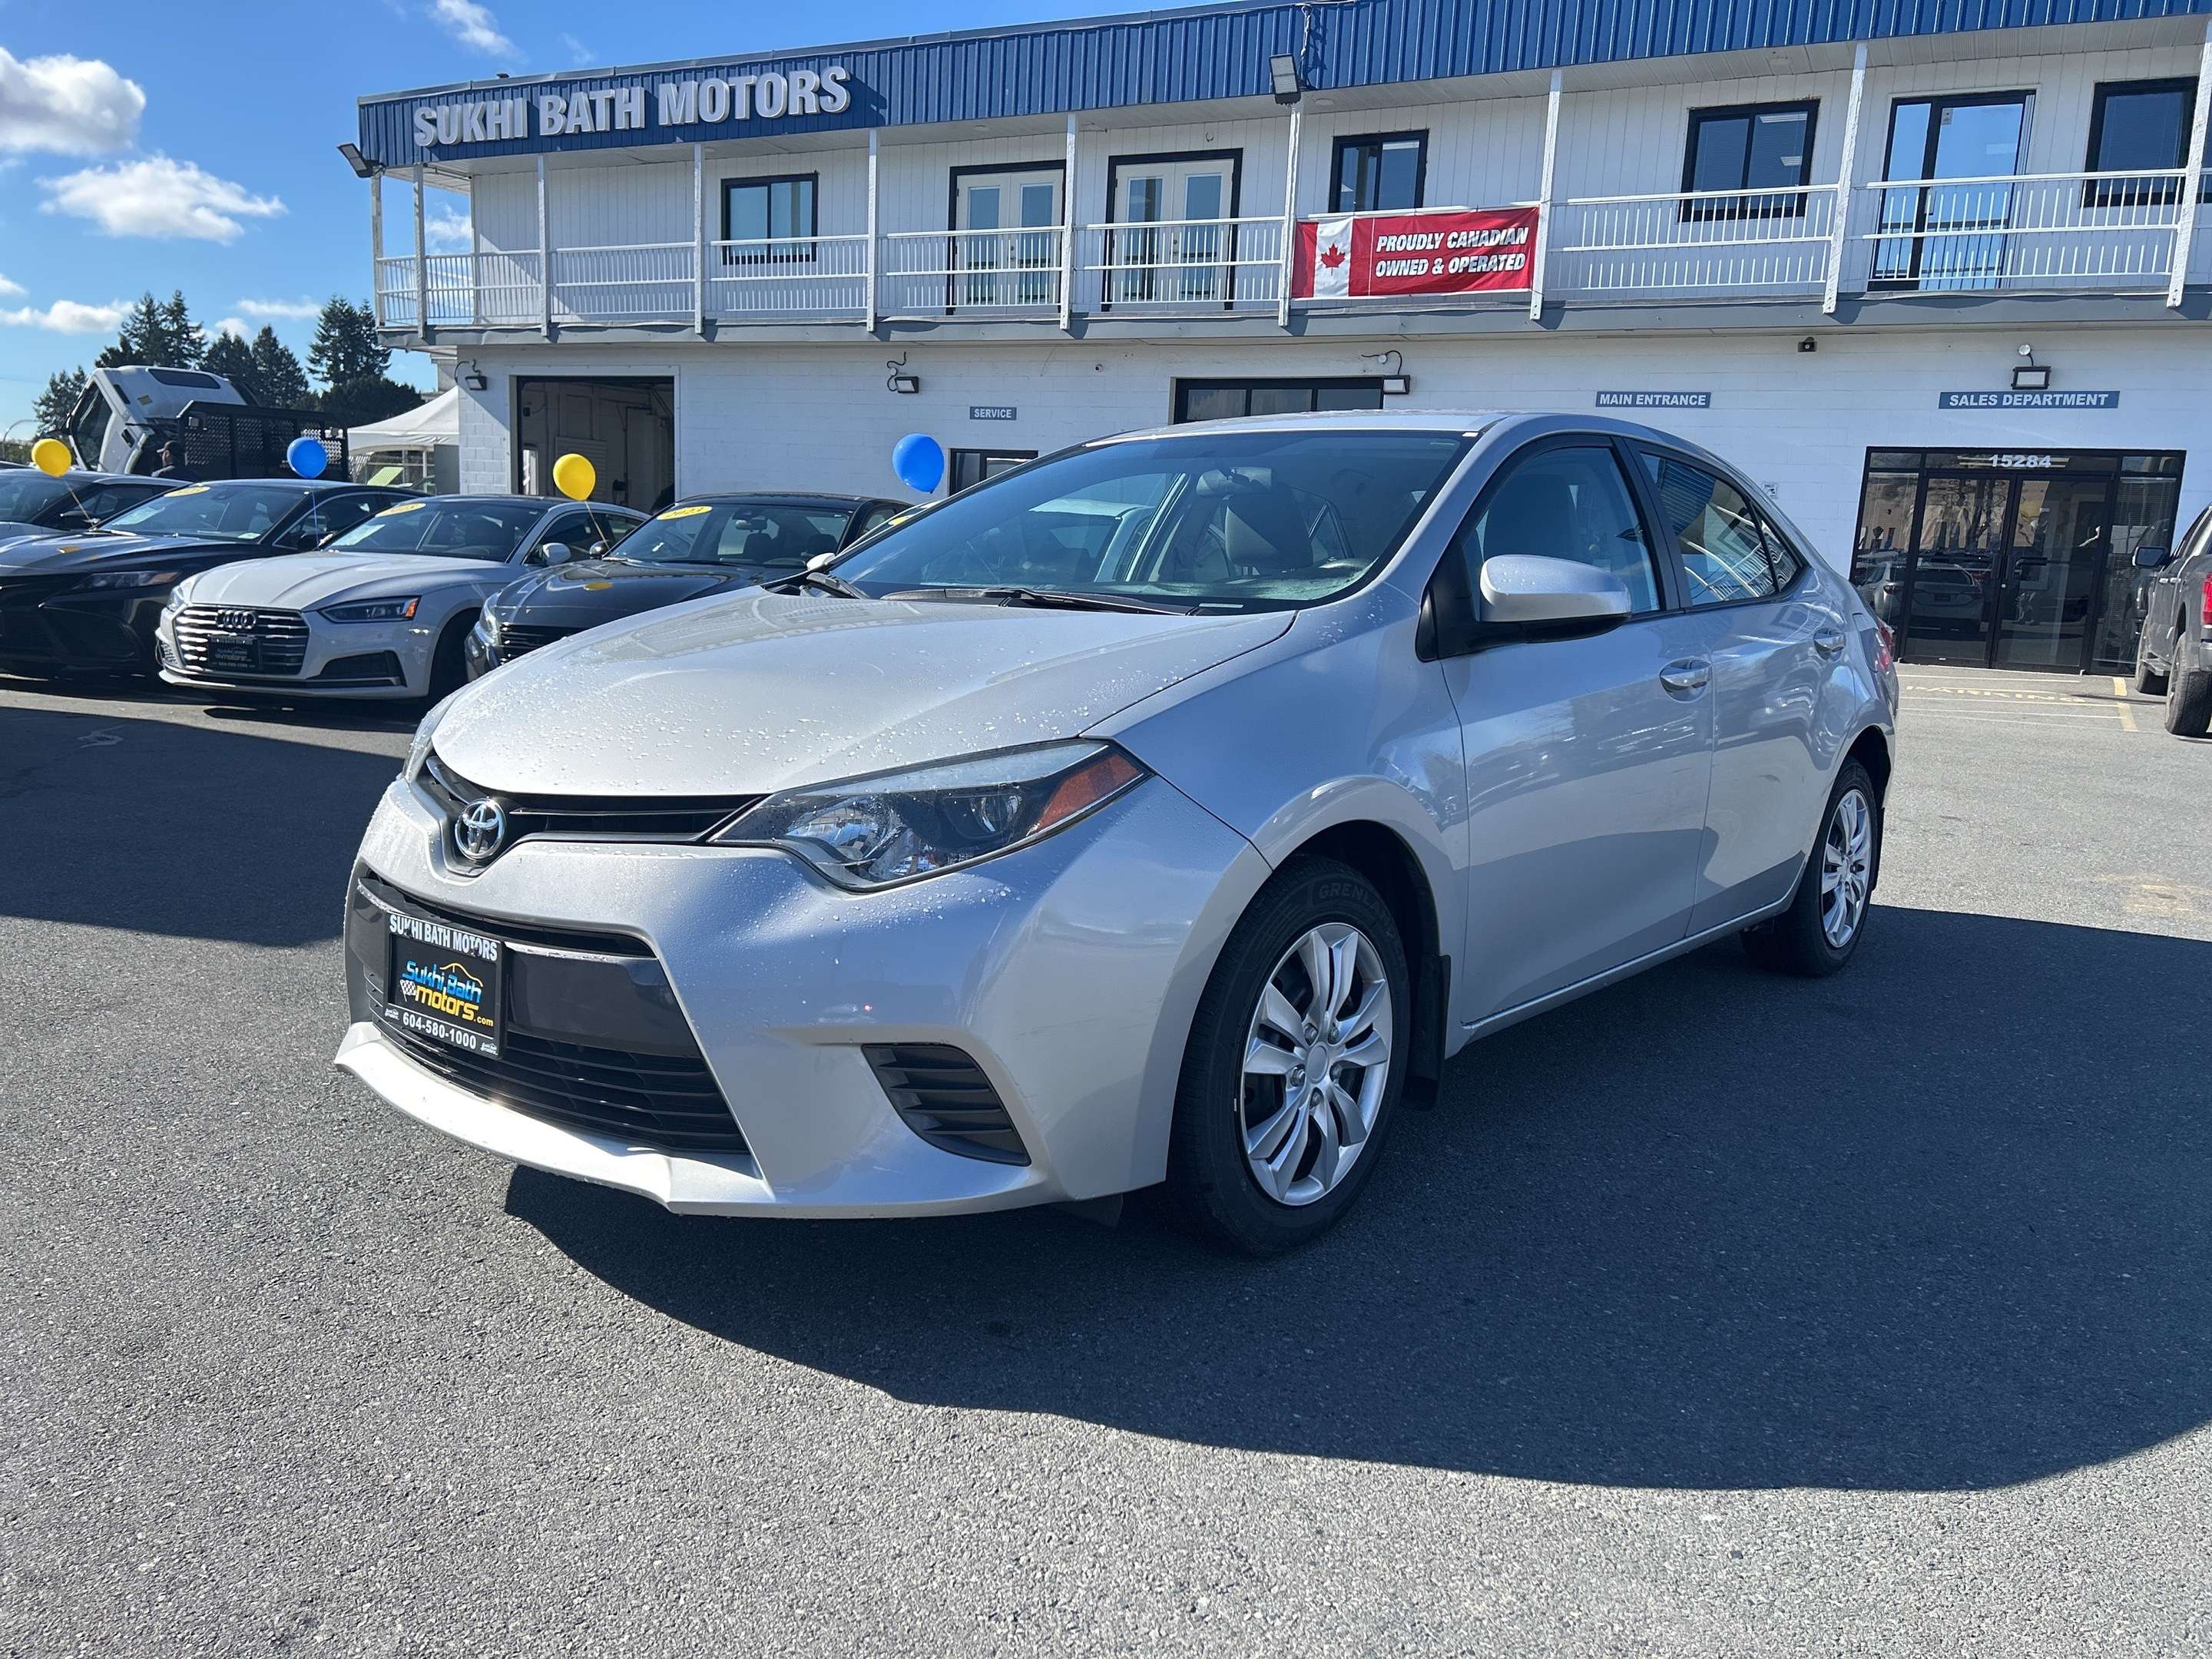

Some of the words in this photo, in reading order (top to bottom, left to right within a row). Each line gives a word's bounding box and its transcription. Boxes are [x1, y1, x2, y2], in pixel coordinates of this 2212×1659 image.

[414, 98, 528, 148] SUKHI
[539, 86, 645, 137] BATH
[658, 66, 851, 127] MOTORS
[1376, 231, 1445, 253] PROUDLY
[1446, 227, 1529, 249] CANADIAN
[1375, 258, 1429, 277] OWNED
[1431, 257, 1445, 275] &
[1448, 253, 1526, 274] OPERATED
[1599, 393, 1633, 406] MAIN
[1635, 394, 1707, 406] ENTRANCE
[1949, 393, 1998, 407] SALES
[2002, 393, 2109, 406] DEPARTMENT
[974, 408, 1012, 419] SERVICE
[1989, 454, 2051, 469] 15284
[389, 914, 422, 941] SUKHI
[424, 923, 451, 949] BATH
[452, 931, 498, 961] MOTORS
[402, 960, 445, 992] Sukhi
[447, 972, 482, 1003] Bath
[402, 1012, 477, 1050] 604-580-1000
